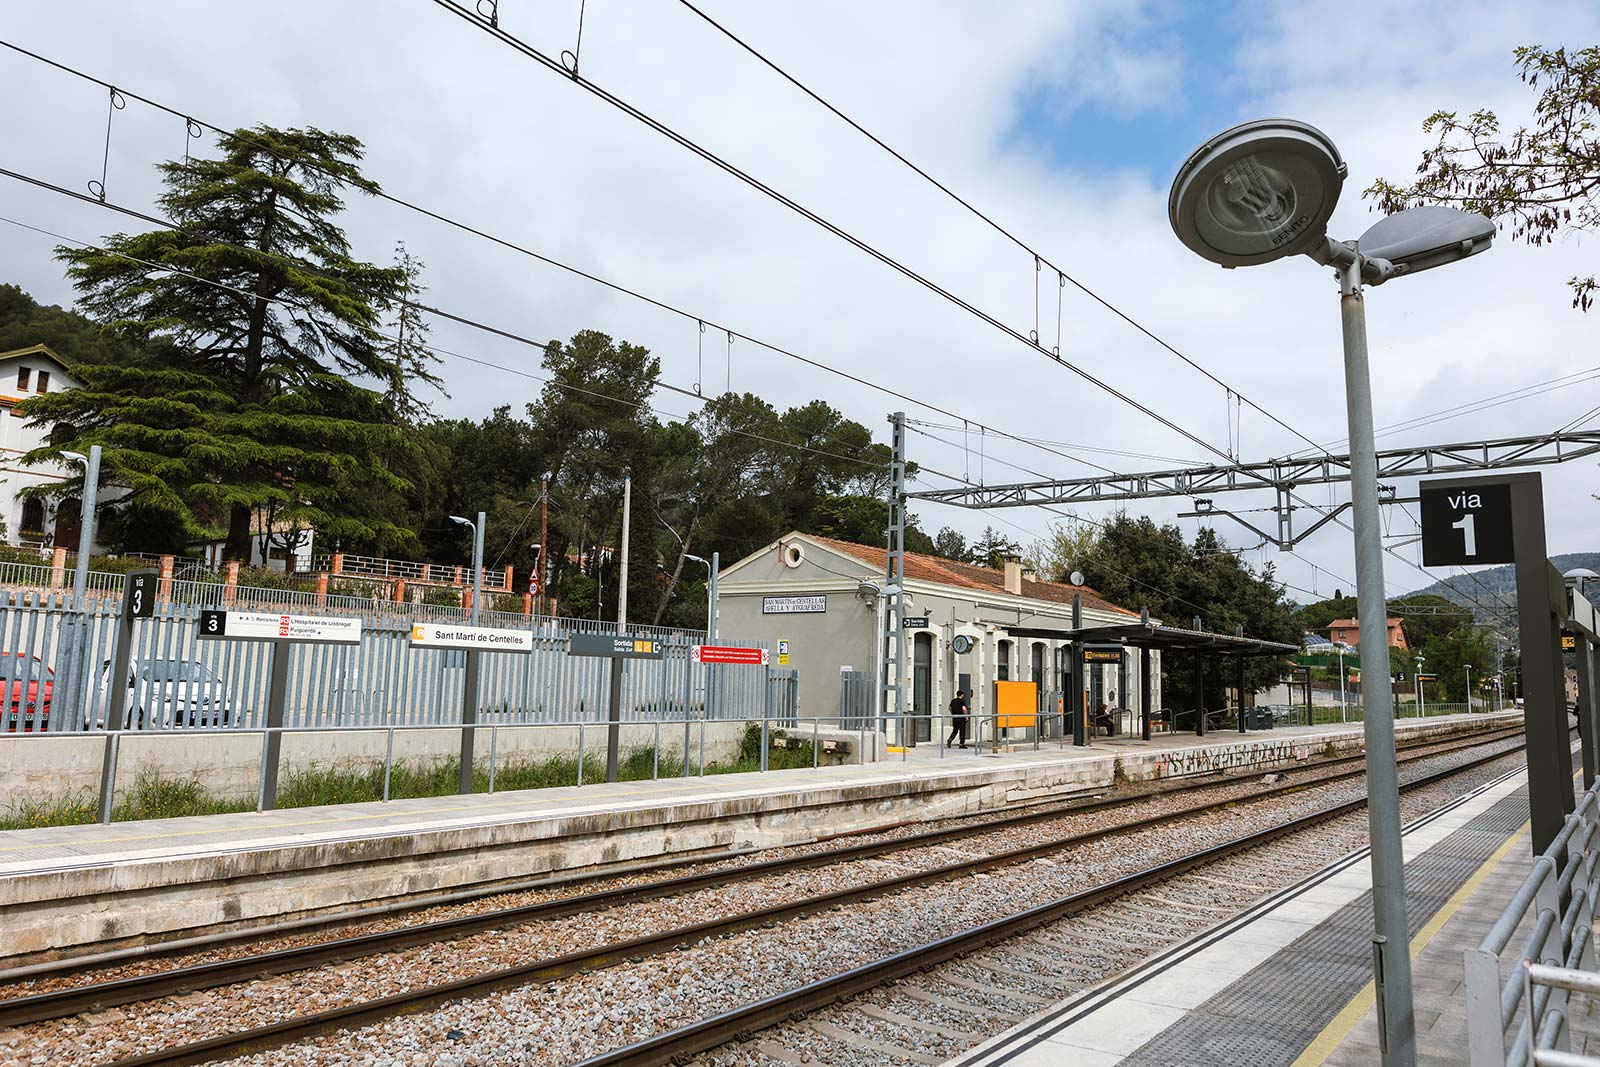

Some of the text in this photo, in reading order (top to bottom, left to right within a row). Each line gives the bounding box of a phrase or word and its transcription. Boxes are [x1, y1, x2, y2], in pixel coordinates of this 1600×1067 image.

[1272, 215, 1309, 245] BENITO
[1448, 491, 1482, 509] via
[1452, 514, 1476, 556] 1
[135, 576, 144, 587] via
[133, 589, 142, 614] 3
[208, 619, 218, 632] 3
[435, 630, 454, 640] Sant
[456, 632, 476, 641] Martí
[478, 633, 487, 642] de
[487, 634, 523, 644] Centelles
[613, 639, 633, 647] Sortida
